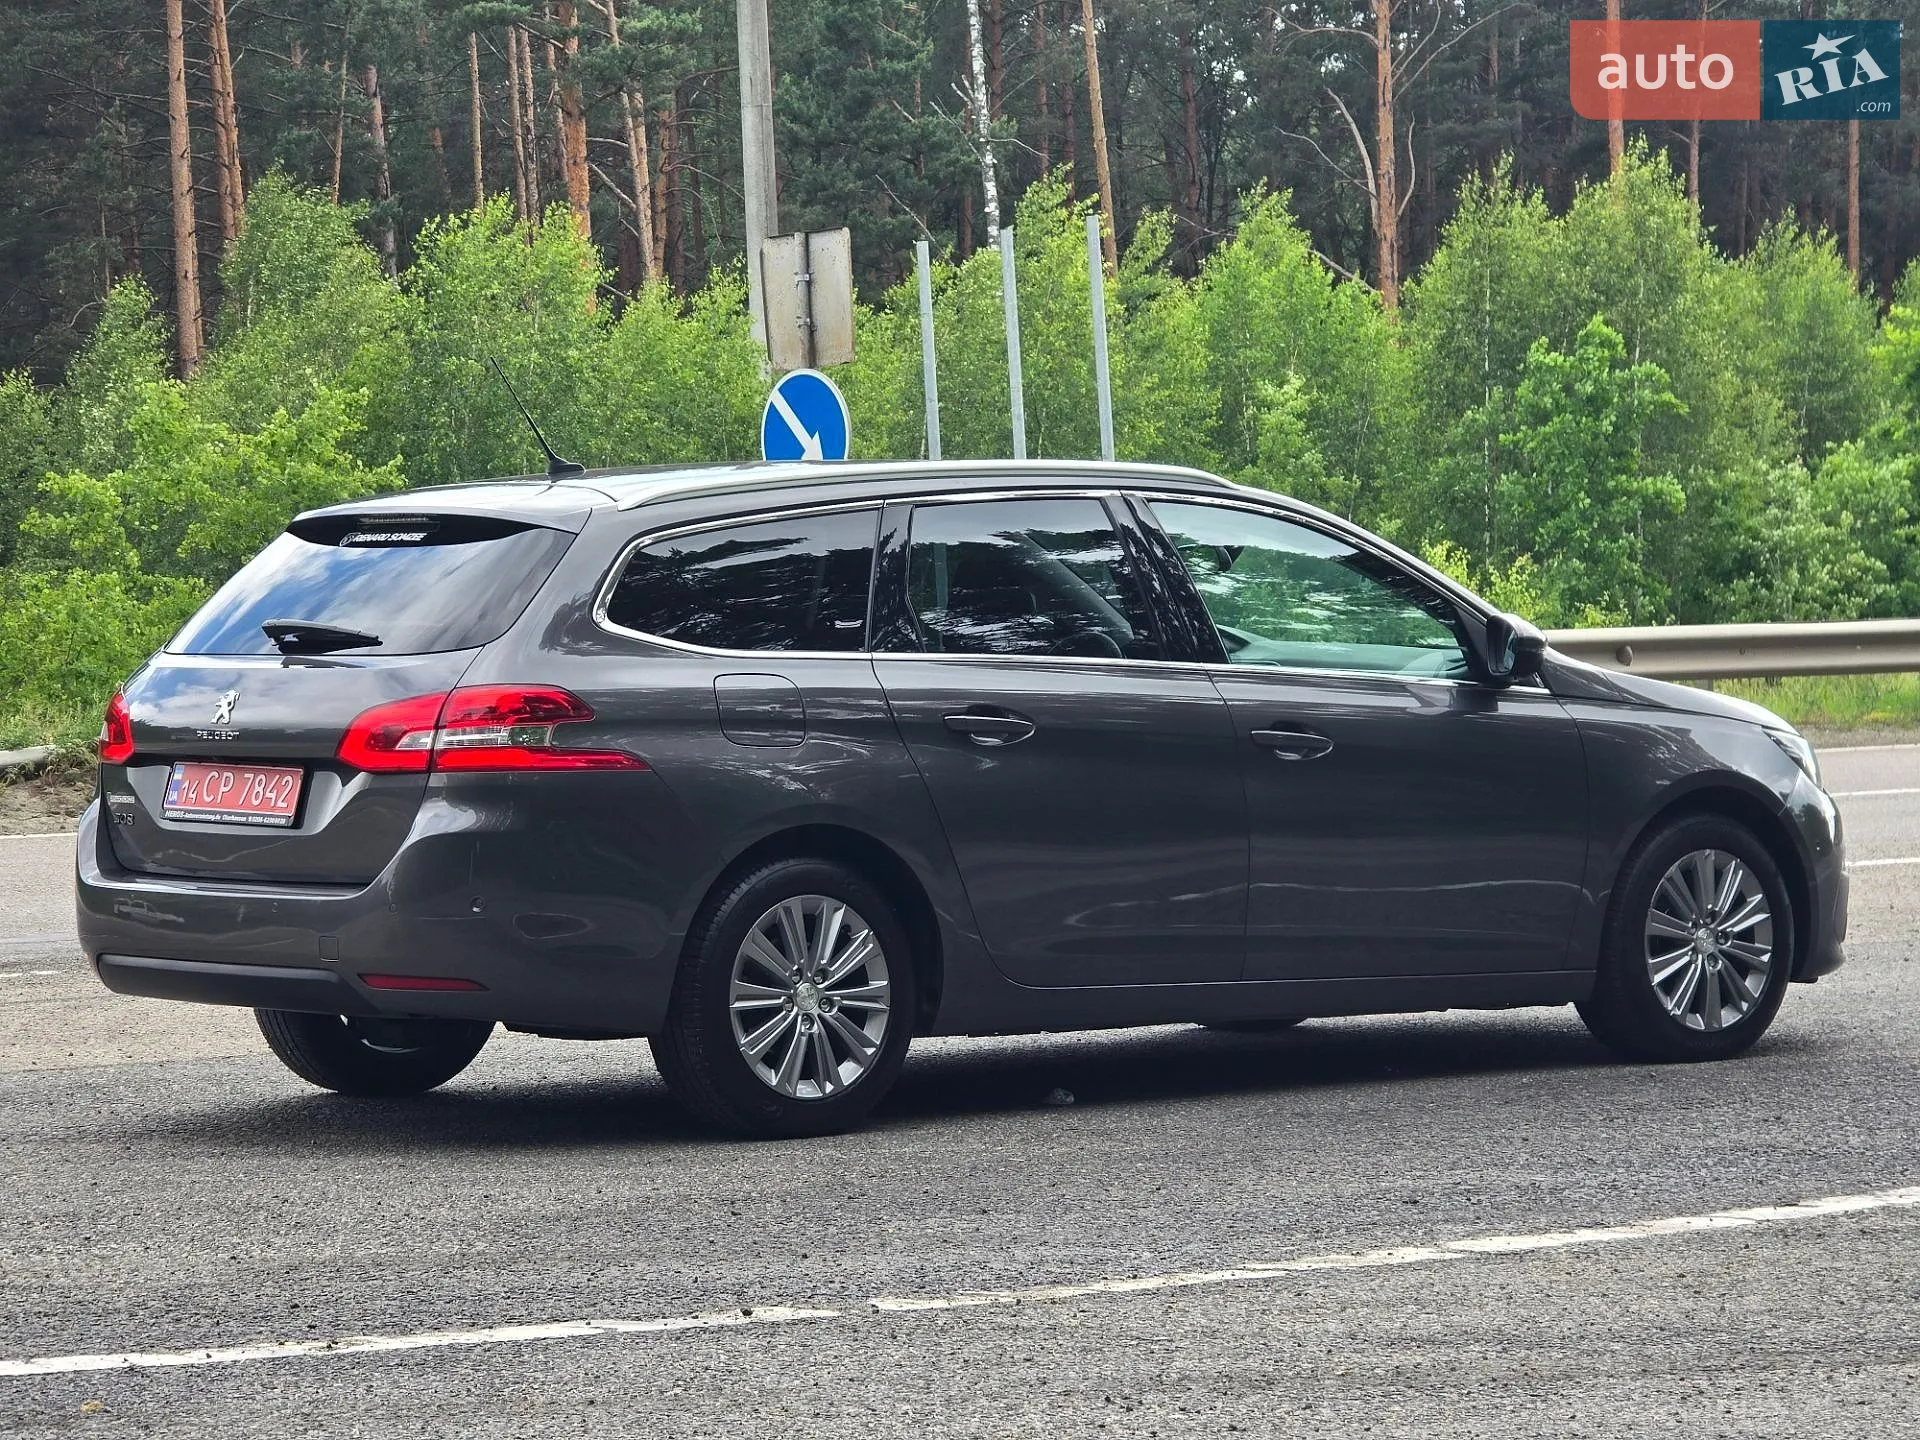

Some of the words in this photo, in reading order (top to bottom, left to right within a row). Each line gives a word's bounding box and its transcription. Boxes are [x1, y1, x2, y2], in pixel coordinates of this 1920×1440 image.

[196, 730, 240, 740] PEUGEOT
[181, 779, 200, 804] 14
[202, 770, 235, 804] CP
[238, 773, 294, 809] 7842
[168, 790, 178, 801] UA
